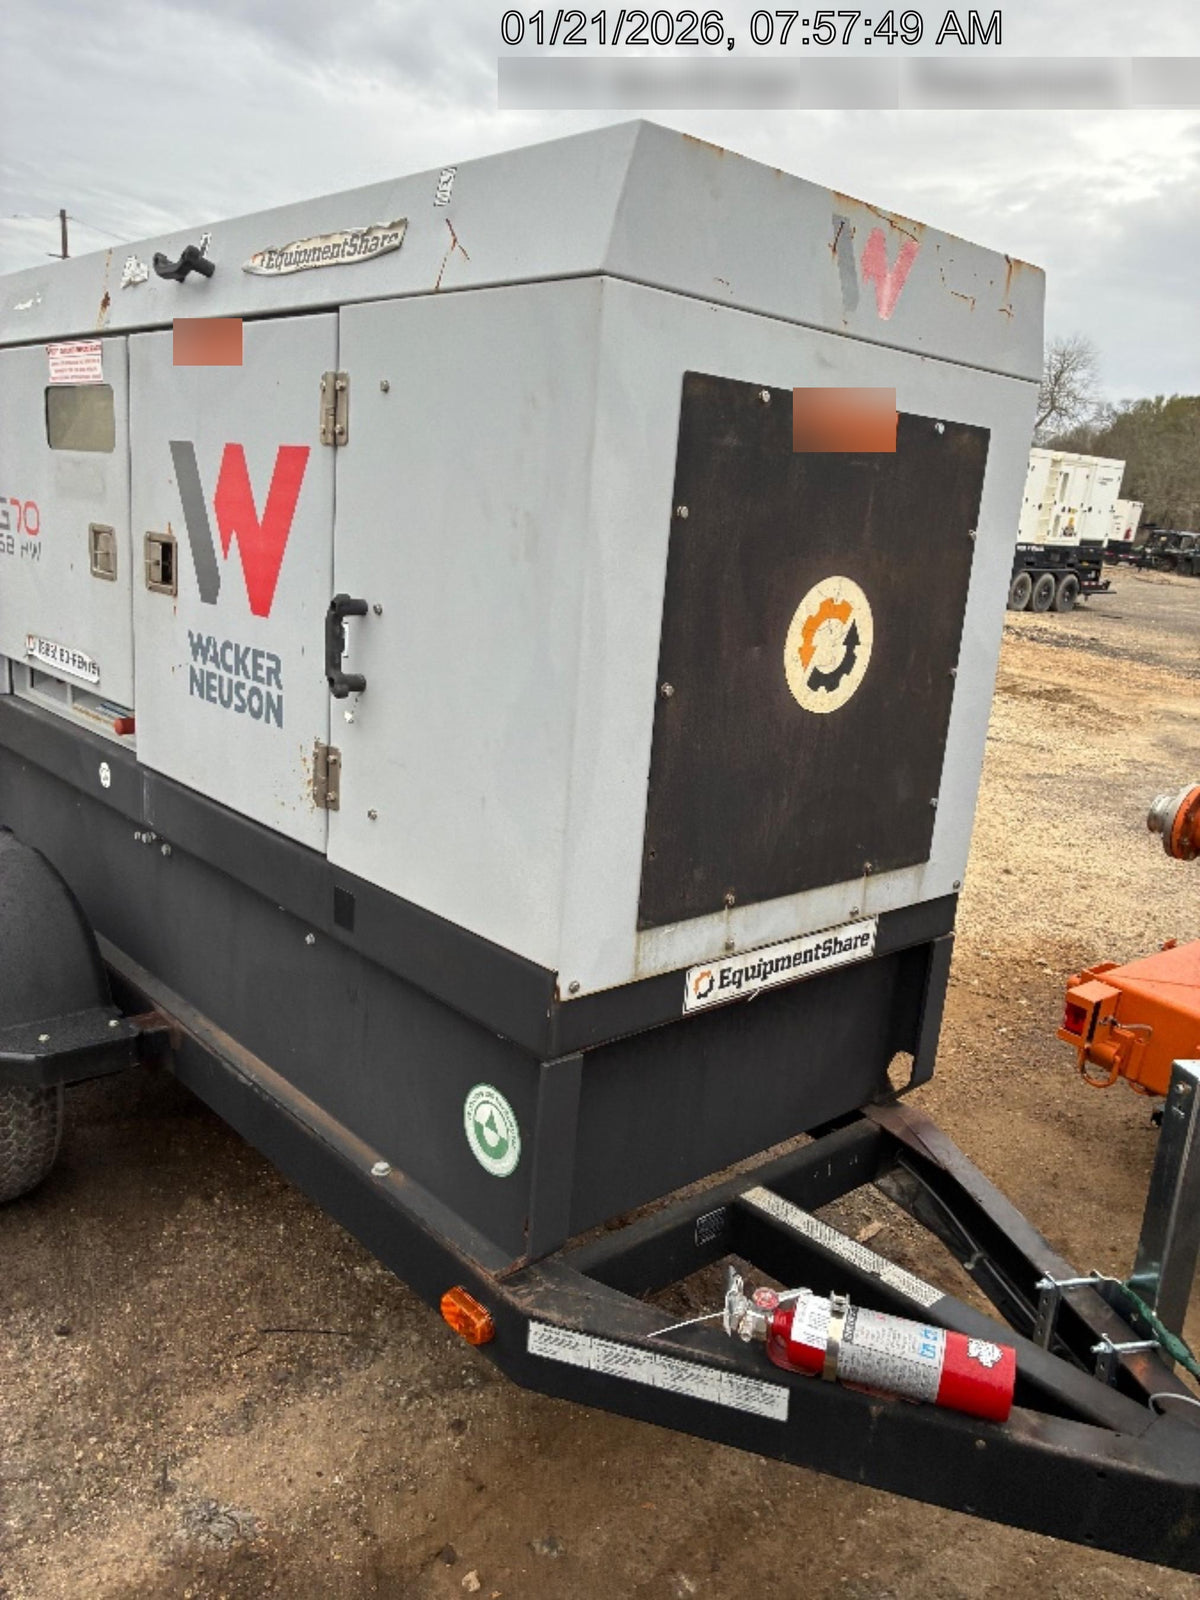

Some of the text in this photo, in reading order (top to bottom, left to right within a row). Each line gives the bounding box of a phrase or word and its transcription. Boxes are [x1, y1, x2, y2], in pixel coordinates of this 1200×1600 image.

[187, 629, 284, 691] WACKER
[188, 664, 284, 730] NEUSON
[718, 931, 871, 990] EquipmentShare
